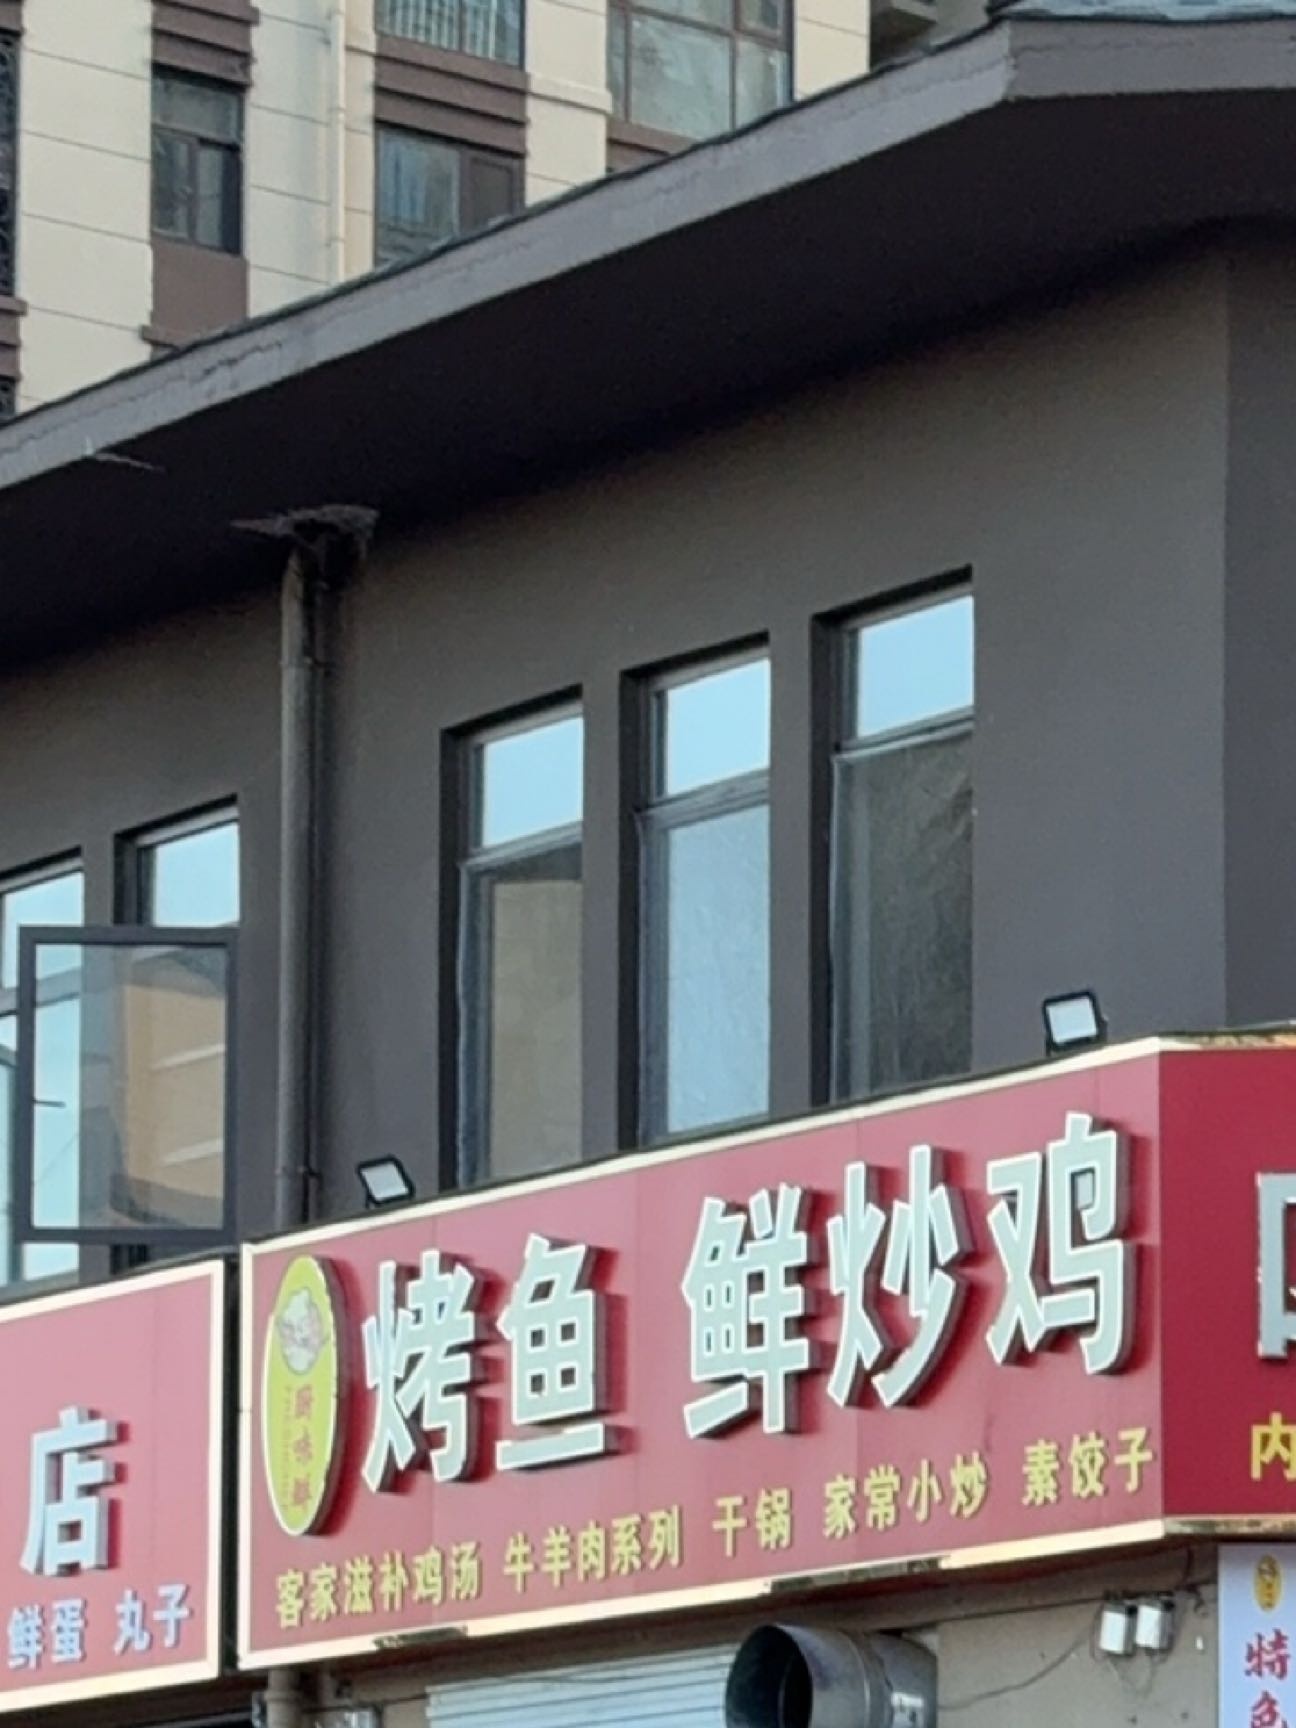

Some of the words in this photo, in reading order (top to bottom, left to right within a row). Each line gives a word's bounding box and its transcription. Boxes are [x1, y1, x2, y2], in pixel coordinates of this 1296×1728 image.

[361, 1233, 607, 1494] 烤鱼
[682, 1111, 1130, 1438] 鲜炒鸡
[20, 1405, 112, 1576] 店
[276, 1543, 480, 1629] 客家滋补鸡汤
[502, 1504, 683, 1593] 牛羊肉系列
[712, 1488, 794, 1557] 干锅
[821, 1454, 990, 1540] 家常小炒
[1021, 1427, 1155, 1508] 素饺子
[7, 1599, 86, 1670] 鲜蛋
[114, 1583, 192, 1655] 丸子
